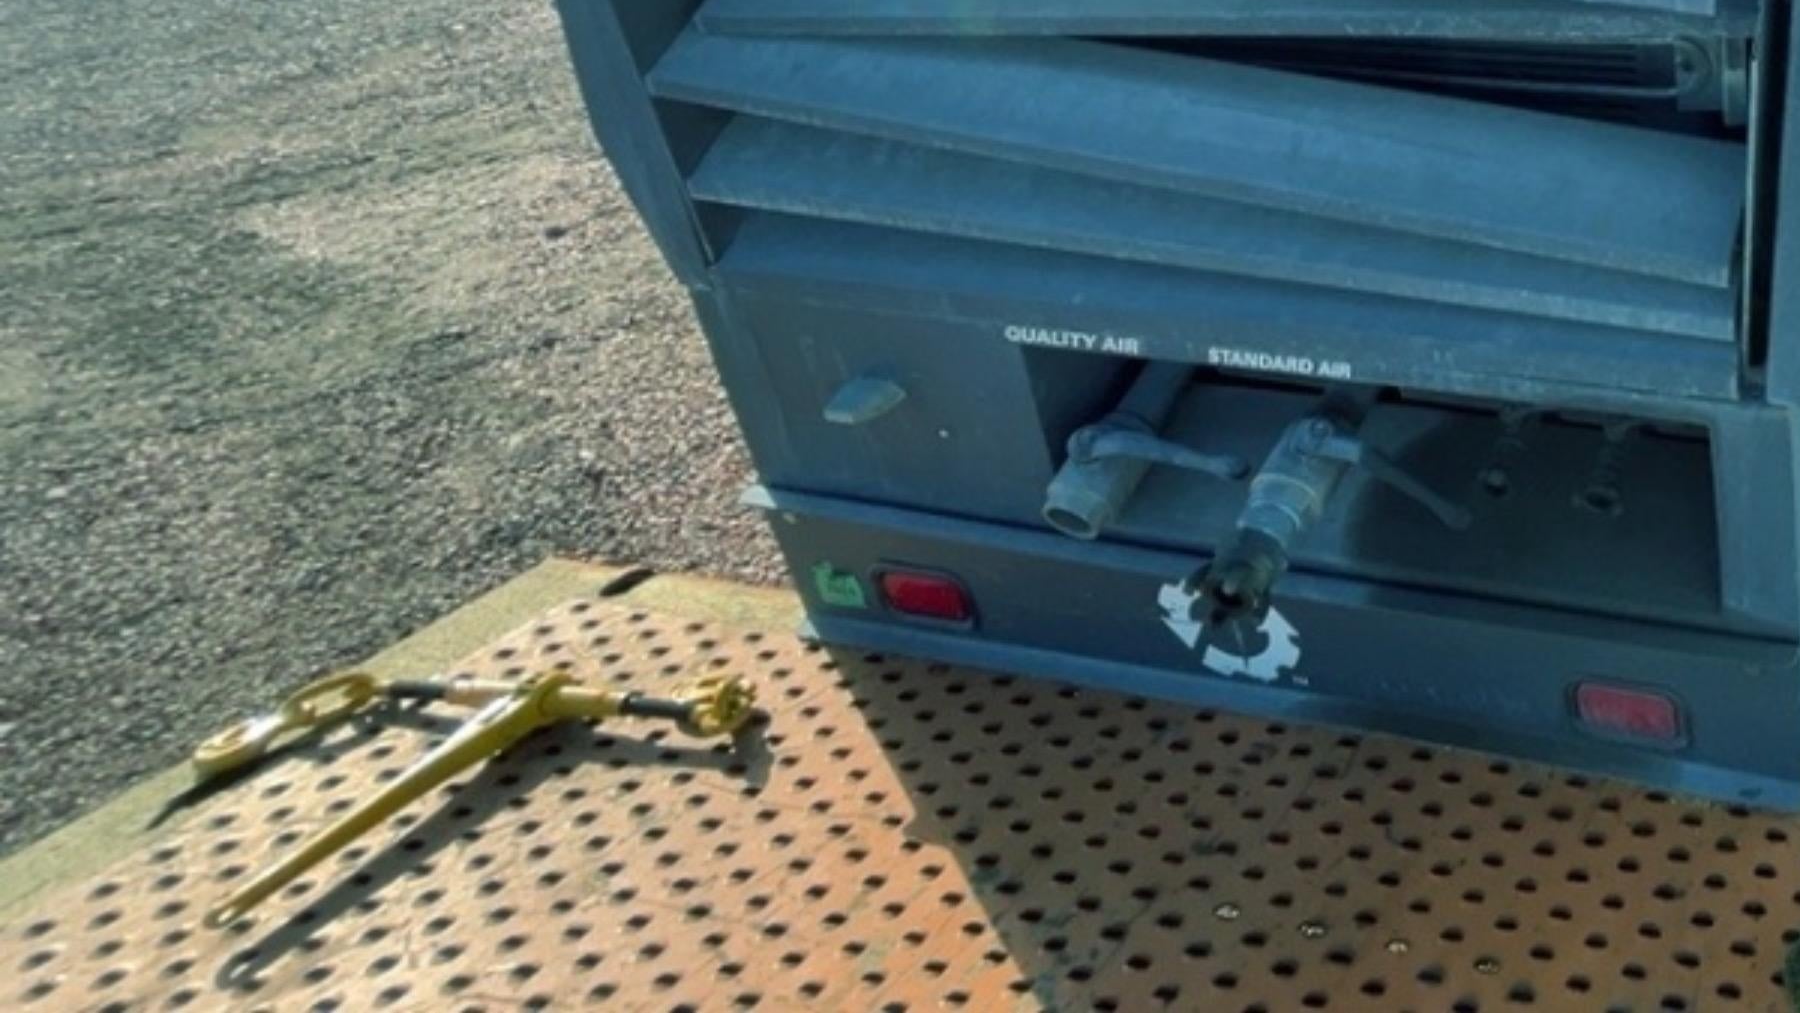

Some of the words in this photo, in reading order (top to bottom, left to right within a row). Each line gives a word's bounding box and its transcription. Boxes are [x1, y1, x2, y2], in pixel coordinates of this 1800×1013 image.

[1004, 324, 1097, 350] QUALITY
[1100, 335, 1140, 355] AIR
[1207, 347, 1314, 376] STANDARD
[1316, 359, 1352, 379] AIR
